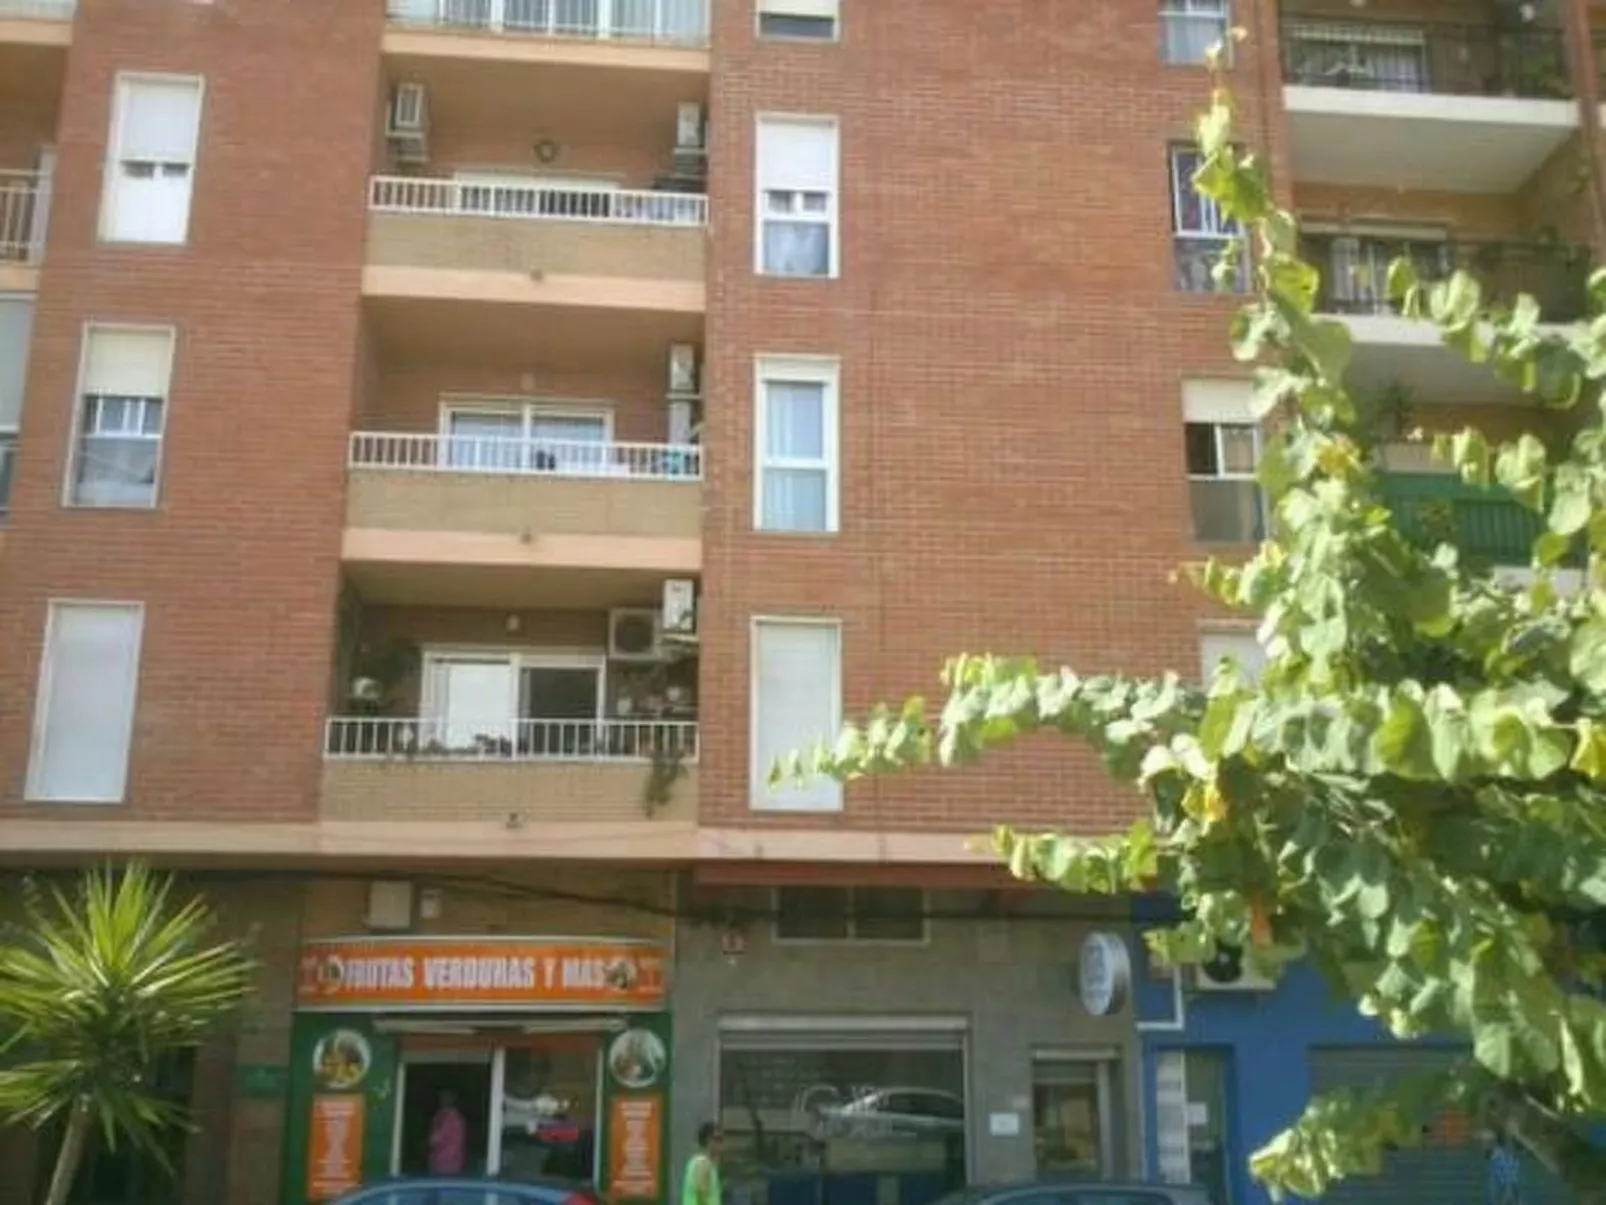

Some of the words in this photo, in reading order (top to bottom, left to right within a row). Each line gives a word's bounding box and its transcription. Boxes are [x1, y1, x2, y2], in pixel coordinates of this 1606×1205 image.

[345, 956, 414, 990] FRUTAS
[424, 955, 534, 990] VERDURAS
[543, 956, 558, 990] Y
